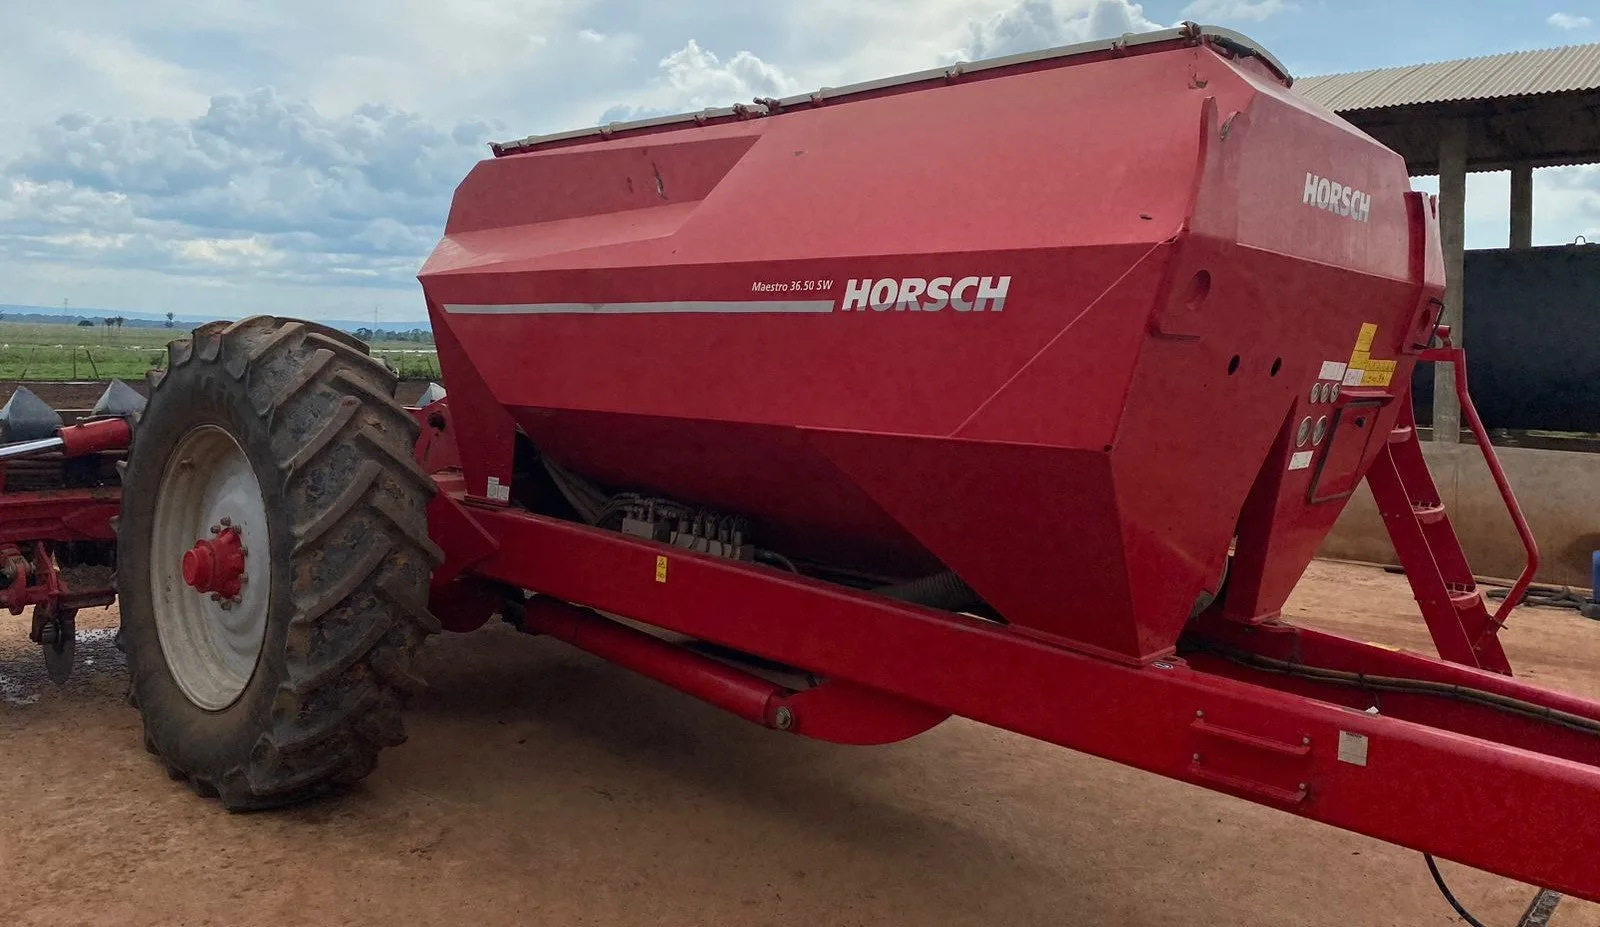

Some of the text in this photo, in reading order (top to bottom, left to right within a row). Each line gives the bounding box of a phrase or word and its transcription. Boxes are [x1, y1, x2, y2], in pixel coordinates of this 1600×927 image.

[1302, 171, 1371, 223] HORSCH
[751, 279, 834, 292] Maestro 36.50 SW
[841, 276, 1012, 312] HORSCH
